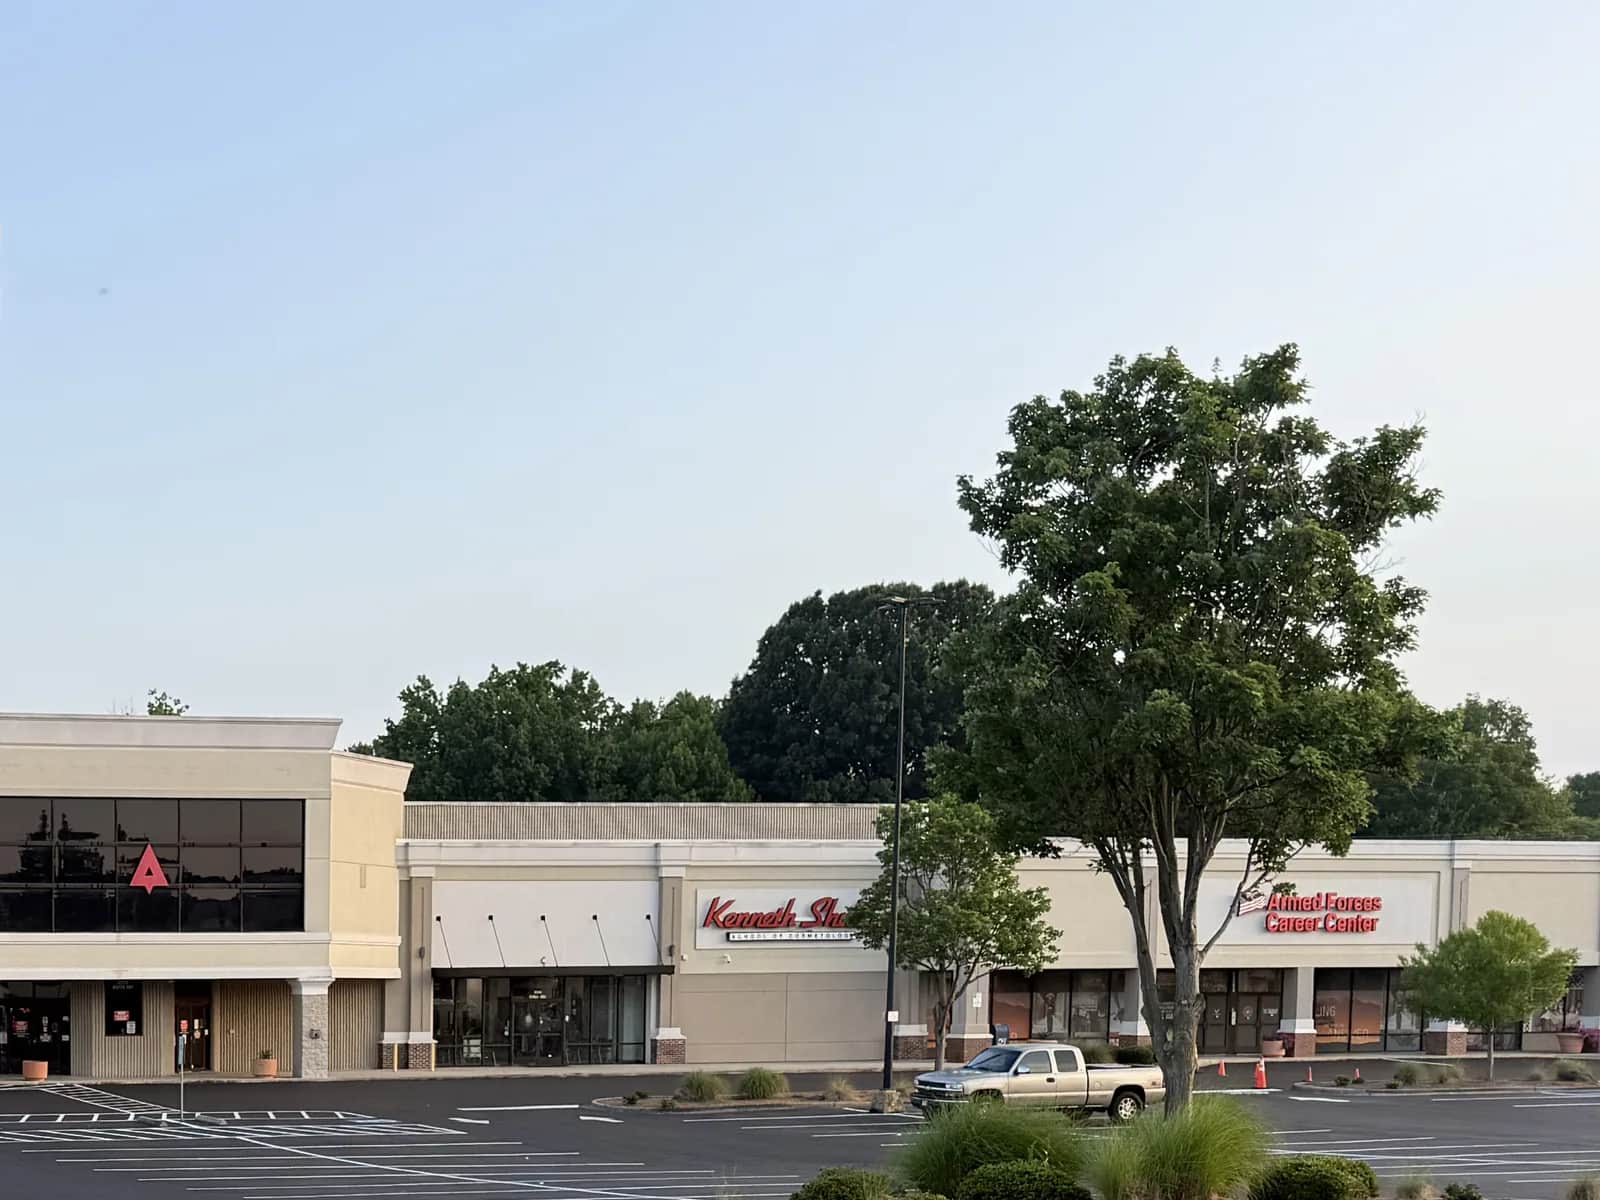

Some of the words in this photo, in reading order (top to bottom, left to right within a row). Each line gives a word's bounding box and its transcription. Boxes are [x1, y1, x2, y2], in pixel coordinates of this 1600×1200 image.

[1267, 892, 1323, 911] Armed
[1326, 892, 1382, 911] Forces
[703, 897, 796, 928] Kenneth
[1266, 913, 1321, 932] Career
[1324, 913, 1379, 932] Center
